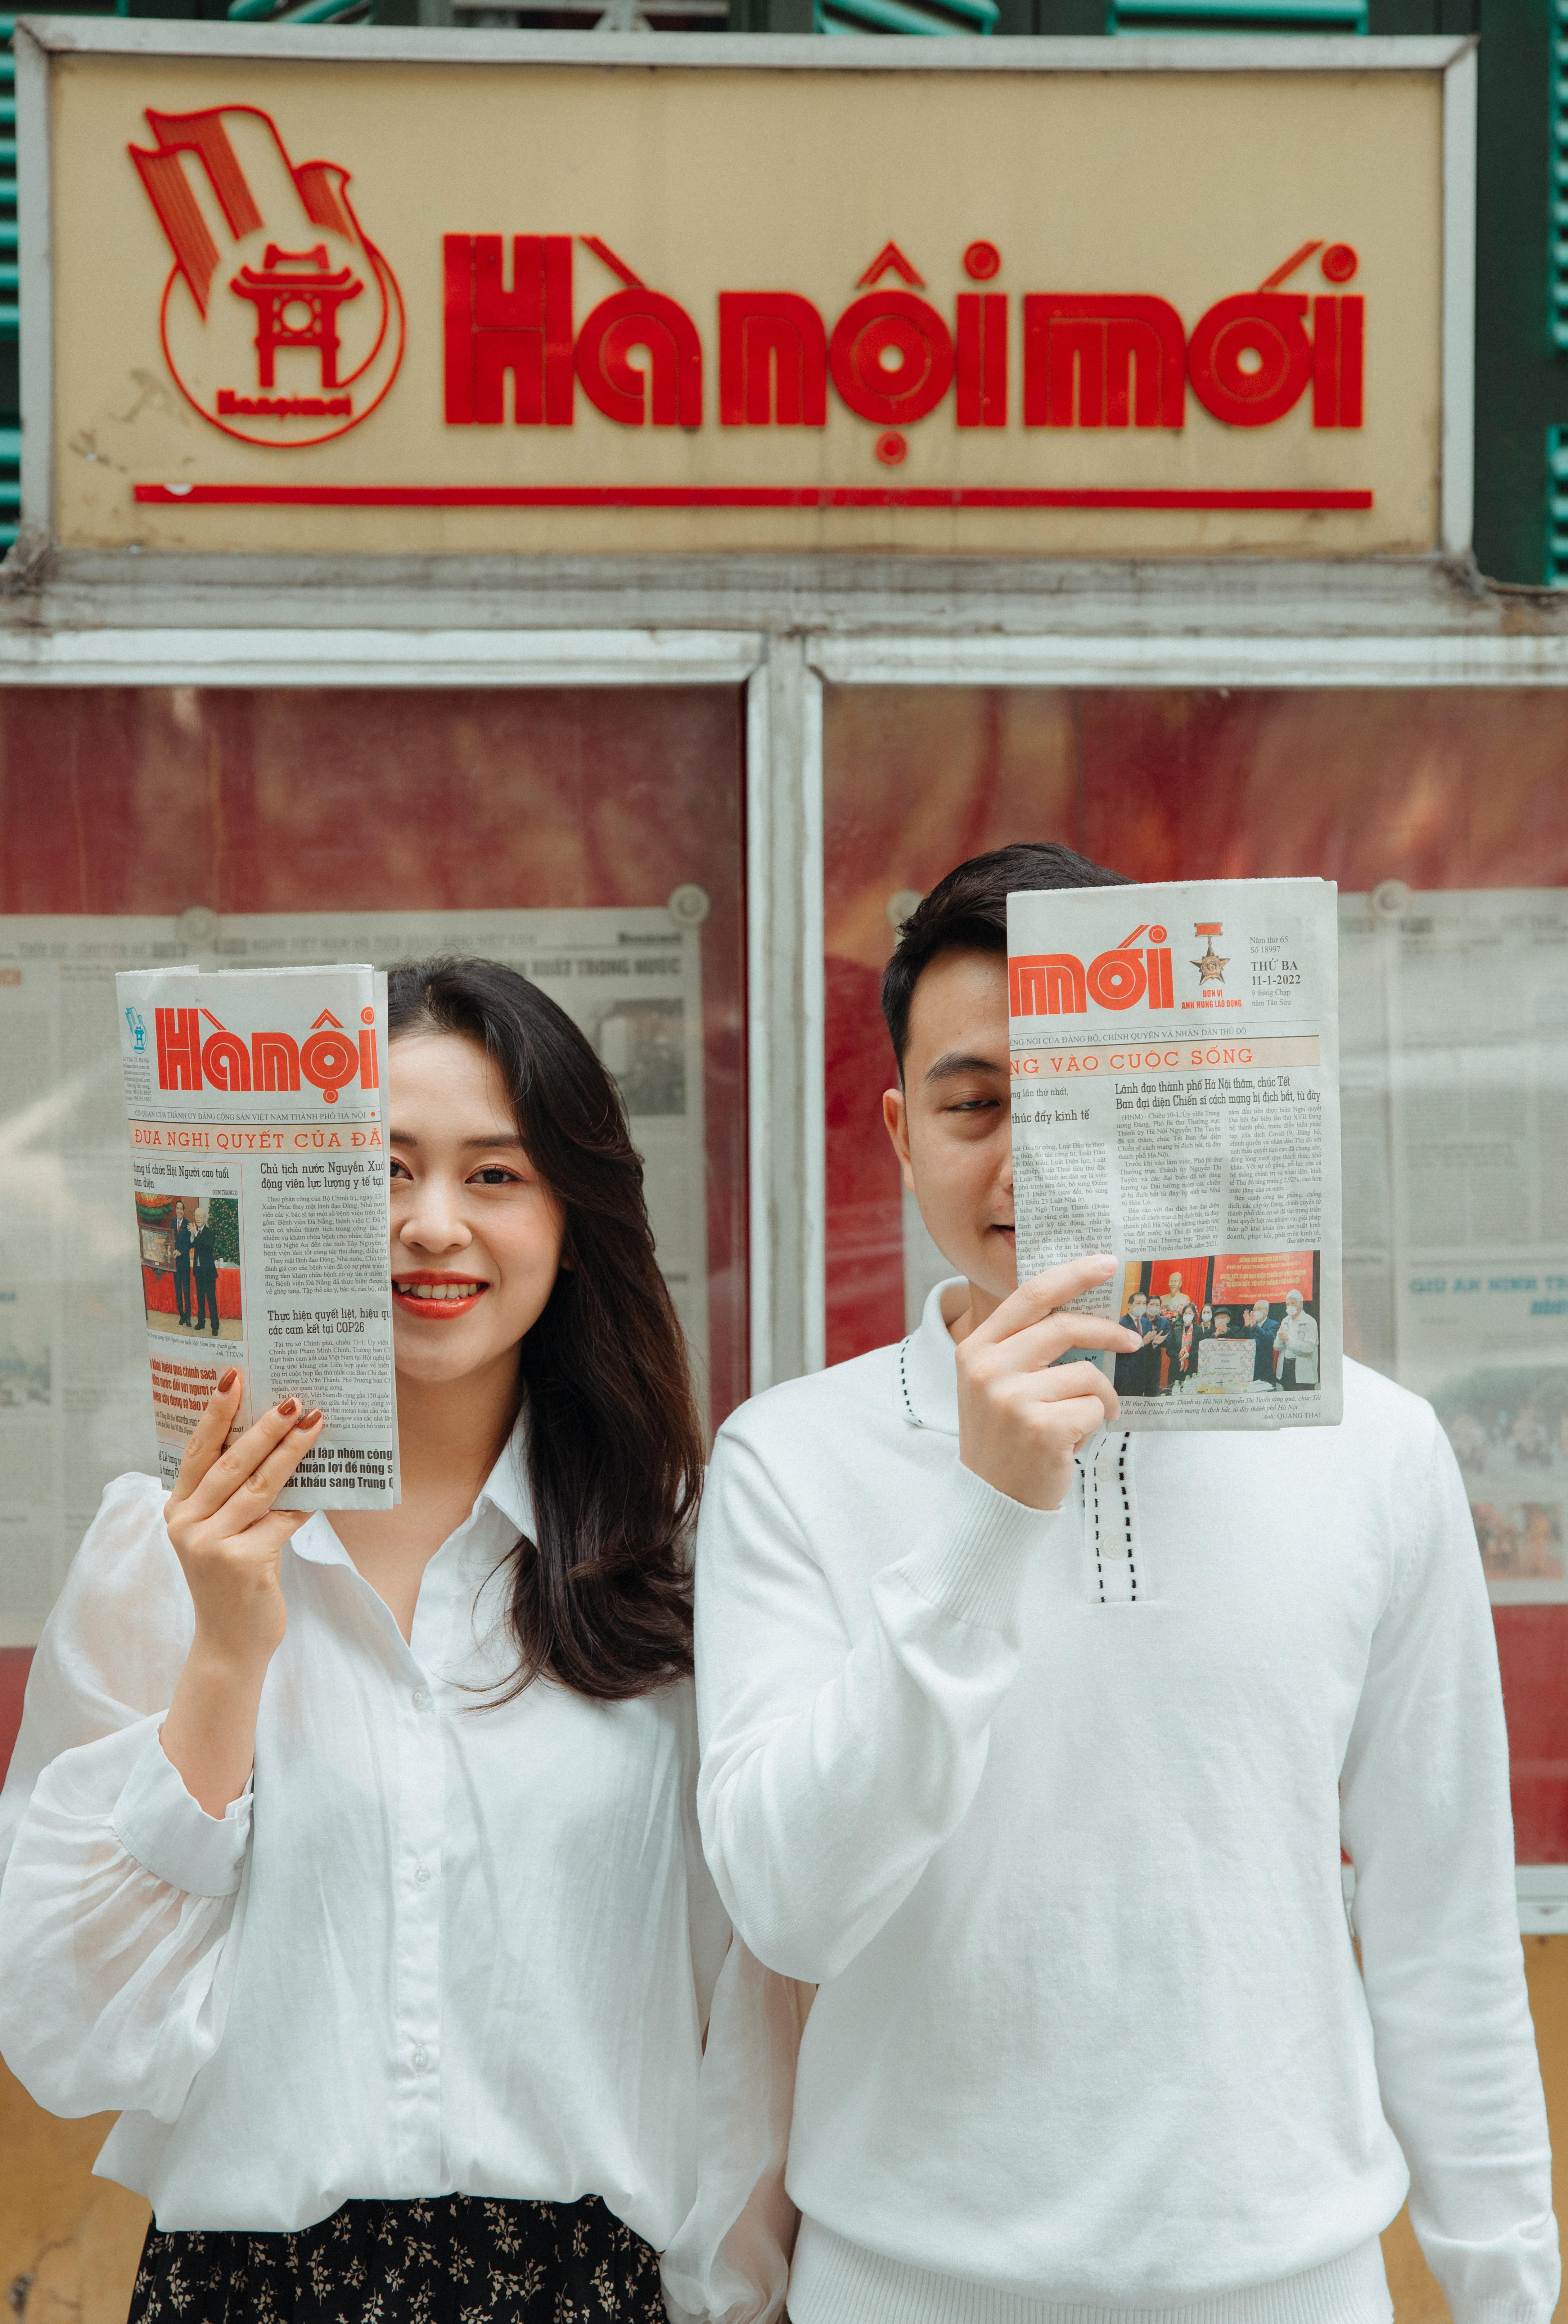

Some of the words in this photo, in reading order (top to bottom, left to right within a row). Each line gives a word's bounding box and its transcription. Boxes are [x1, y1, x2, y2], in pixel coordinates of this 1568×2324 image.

[1008, 924, 1174, 1017] mới
[1251, 958, 1278, 971] THỨ
[1281, 961, 1298, 970] BA
[1252, 974, 1301, 985] 11-1-2022
[1043, 1036, 1060, 1044] CỦA
[1062, 1035, 1085, 1043] ĐẢNG
[1087, 1033, 1101, 1042] BỘ,
[1103, 1032, 1128, 1041] CHÍNH
[1131, 1031, 1159, 1040] QUYỀN
[1202, 1028, 1217, 1036] DÂN
[1220, 1026, 1234, 1035] THỦ
[155, 1006, 379, 1104] Hànội
[1009, 1059, 1039, 1075] NG
[1050, 1054, 1098, 1072] VÀO
[1110, 1051, 1179, 1069] CUỘC
[1191, 1045, 1252, 1064] SỐNG
[1050, 1087, 1068, 1096] nhất,
[1115, 1082, 1139, 1094] Lãnh
[1141, 1082, 1156, 1094] đạo
[1158, 1080, 1184, 1092] thành
[1186, 1079, 1203, 1093] phố
[1204, 1079, 1216, 1090] Hà
[1218, 1078, 1231, 1090] Nội
[1233, 1077, 1255, 1089] thăm,
[1258, 1076, 1275, 1087] chúc
[1278, 1075, 1290, 1086] Tết
[1116, 1098, 1134, 1109] Ban
[1136, 1097, 1150, 1109] đại
[1152, 1096, 1171, 1108] diện
[1173, 1094, 1198, 1106] Chiến
[1200, 1095, 1207, 1105] sĩ
[1209, 1093, 1226, 1104] cách
[1229, 1095, 1251, 1105] mạng
[1253, 1092, 1260, 1104] bị
[1263, 1091, 1279, 1103] địch
[1280, 1090, 1294, 1102] bắt,
[1297, 1091, 1305, 1100] tù
[1307, 1089, 1320, 1102] đày
[156, 1110, 166, 1118] CỦA
[167, 1111, 186, 1119] THÀNH
[217, 1112, 234, 1121] CỘNG
[252, 1113, 269, 1121] VIỆT
[351, 1111, 366, 1120] NỘI
[1012, 1113, 1031, 1123] thúc
[1035, 1110, 1052, 1124] đẩy
[1055, 1109, 1077, 1121] kinh
[1081, 1108, 1090, 1120] tế
[135, 1129, 161, 1144] ĐƯA
[167, 1132, 209, 1149] NGHỊ
[216, 1130, 284, 1150] QUYẾT
[294, 1130, 341, 1148] CỦA
[352, 1128, 381, 1146] ĐẢ
[145, 1163, 150, 1174] tổ
[152, 1164, 165, 1175] chức
[166, 1165, 177, 1177] Hội
[178, 1166, 200, 1179] Người
[216, 1167, 229, 1178] tuổi
[261, 1163, 278, 1174] Chủ
[281, 1163, 298, 1175] tịch
[302, 1163, 324, 1173] nước
[328, 1161, 364, 1175] Nguyễn
[143, 1177, 154, 1189] diện
[261, 1177, 283, 1191] động
[285, 1179, 305, 1188] viên
[307, 1177, 321, 1189] lực
[324, 1177, 350, 1189] lượng
[353, 1179, 359, 1189] y
[362, 1175, 370, 1186] tế
[373, 1176, 384, 1187] tại
[267, 1310, 290, 1322] Thực
[292, 1310, 312, 1321] hiện
[315, 1308, 338, 1321] quyết
[341, 1308, 357, 1320] liệt,
[360, 1307, 379, 1319] hiệu
[269, 1325, 283, 1335] các
[306, 1323, 320, 1334] kết
[323, 1324, 334, 1334] tại
[337, 1322, 364, 1333] COP26
[318, 1447, 334, 1460] lập
[337, 1448, 365, 1459] nhóm
[367, 1449, 392, 1460] công
[295, 1462, 325, 1476] thuận
[328, 1462, 342, 1474] lợi
[345, 1461, 357, 1473] để
[360, 1463, 384, 1475] nông
[301, 1475, 326, 1487] khẩu
[329, 1478, 355, 1488] sang
[357, 1477, 386, 1490] Trung
